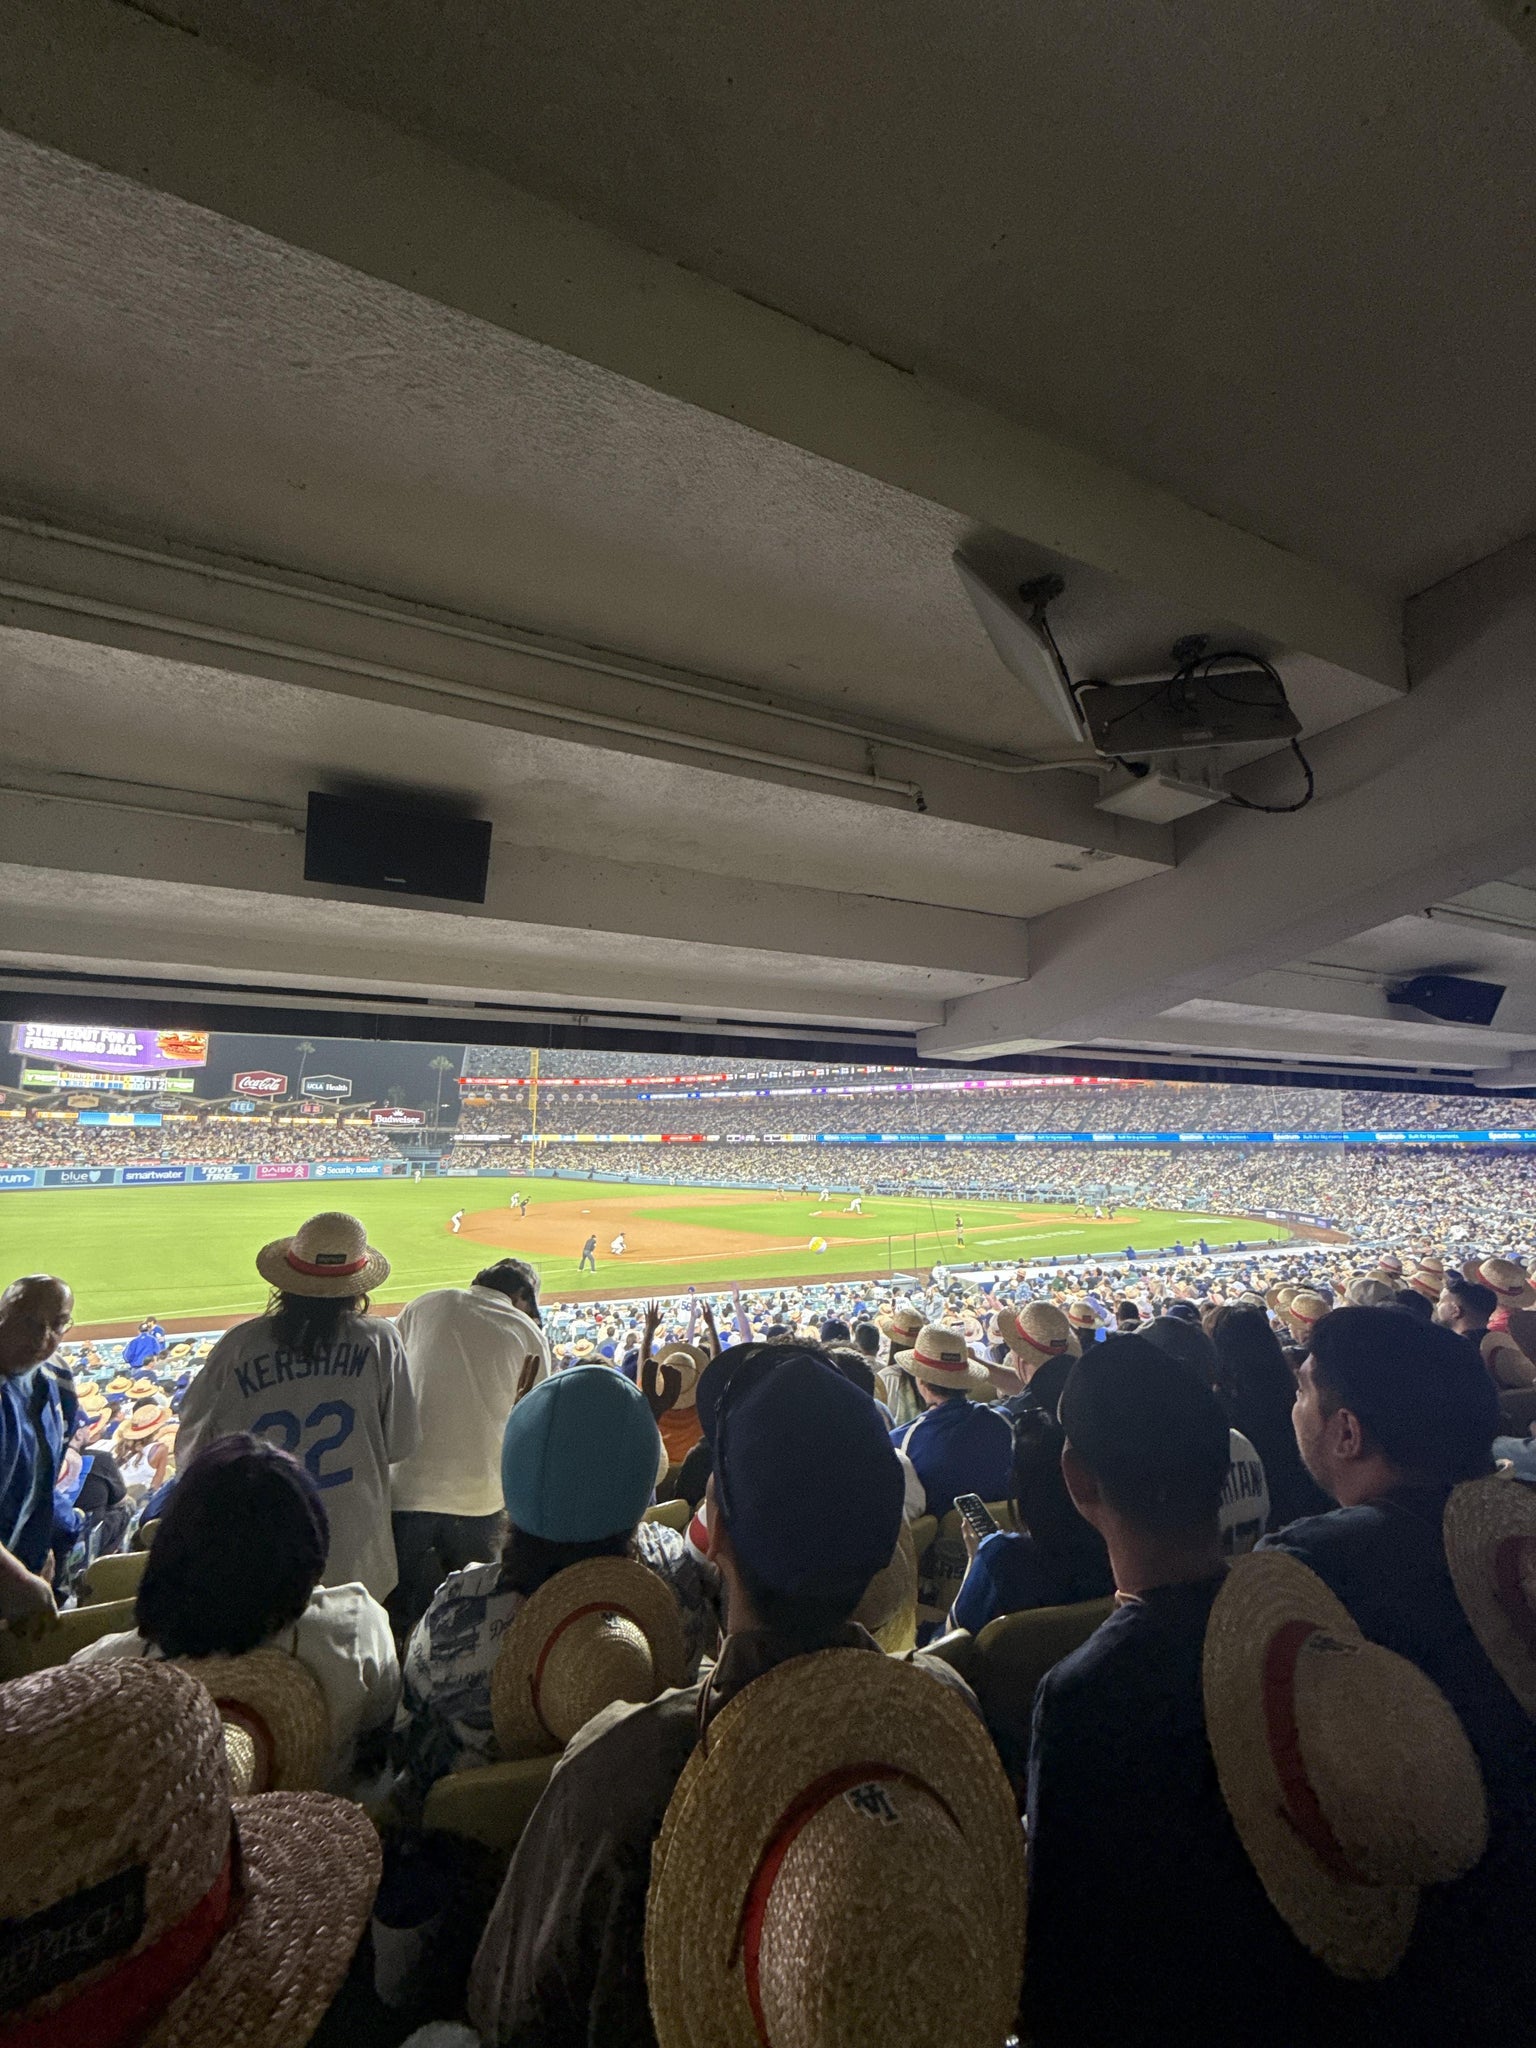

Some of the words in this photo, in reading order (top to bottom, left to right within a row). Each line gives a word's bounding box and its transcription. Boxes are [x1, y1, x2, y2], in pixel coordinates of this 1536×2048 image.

[101, 1031, 125, 1044] FOR
[127, 1033, 136, 1044] A
[24, 1036, 59, 1050] FREE
[60, 1038, 106, 1054] JUMBO
[325, 1083, 348, 1091] Health
[374, 1114, 420, 1123] Budweiser
[125, 1170, 183, 1180] smartwater
[201, 1166, 233, 1174] TOYO
[327, 1166, 355, 1175] Security
[355, 1165, 380, 1174] Benefit
[61, 1171, 88, 1181] blue
[205, 1172, 240, 1181] TIRES
[235, 1342, 370, 1398] KERSHAW
